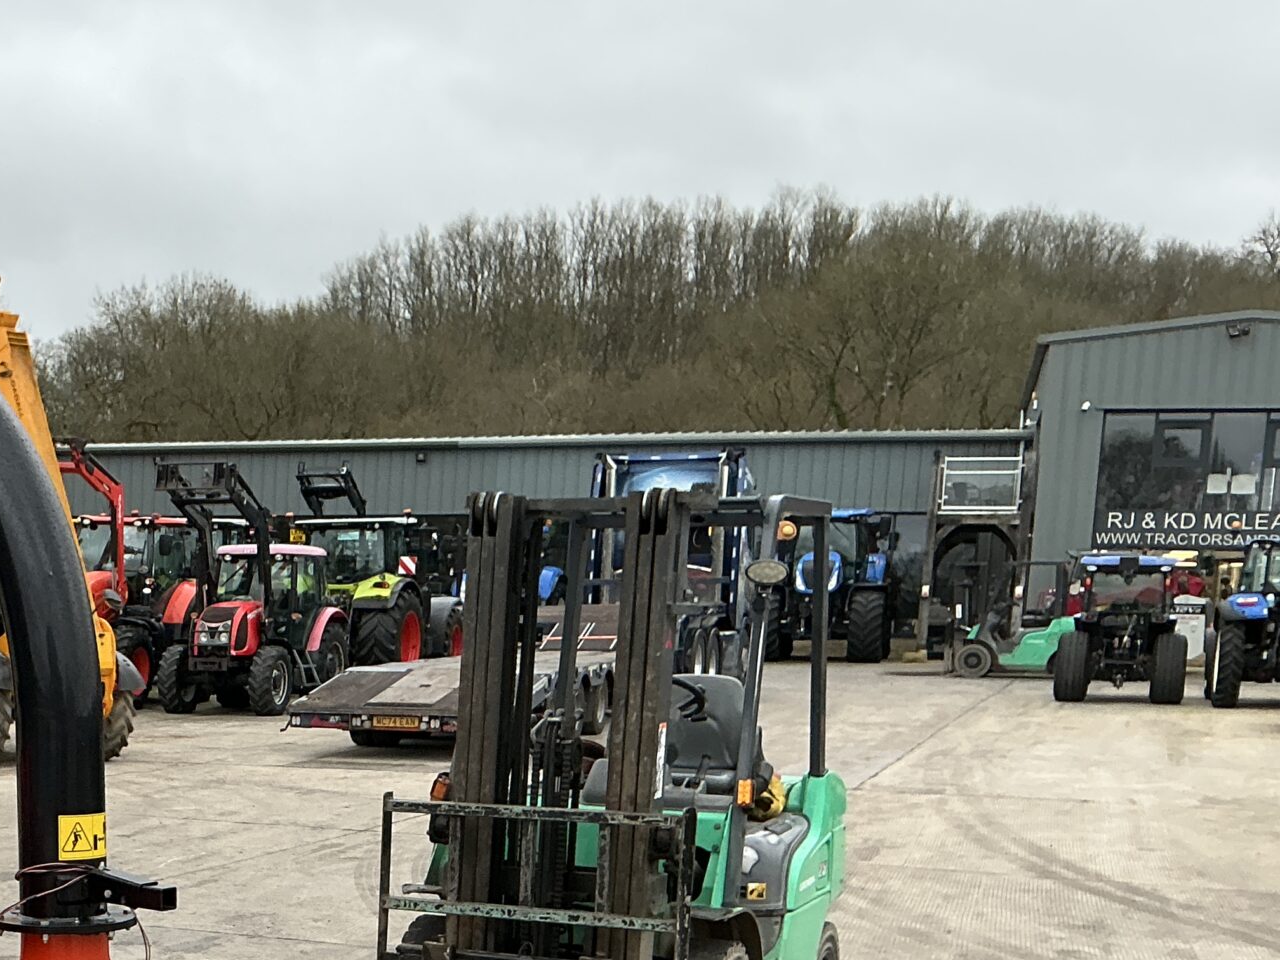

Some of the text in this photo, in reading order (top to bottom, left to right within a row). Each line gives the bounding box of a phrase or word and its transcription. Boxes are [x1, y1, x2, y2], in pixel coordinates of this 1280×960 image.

[1107, 512, 1135, 530] RJ
[1142, 512, 1156, 530] &
[1164, 512, 1196, 530] KD
